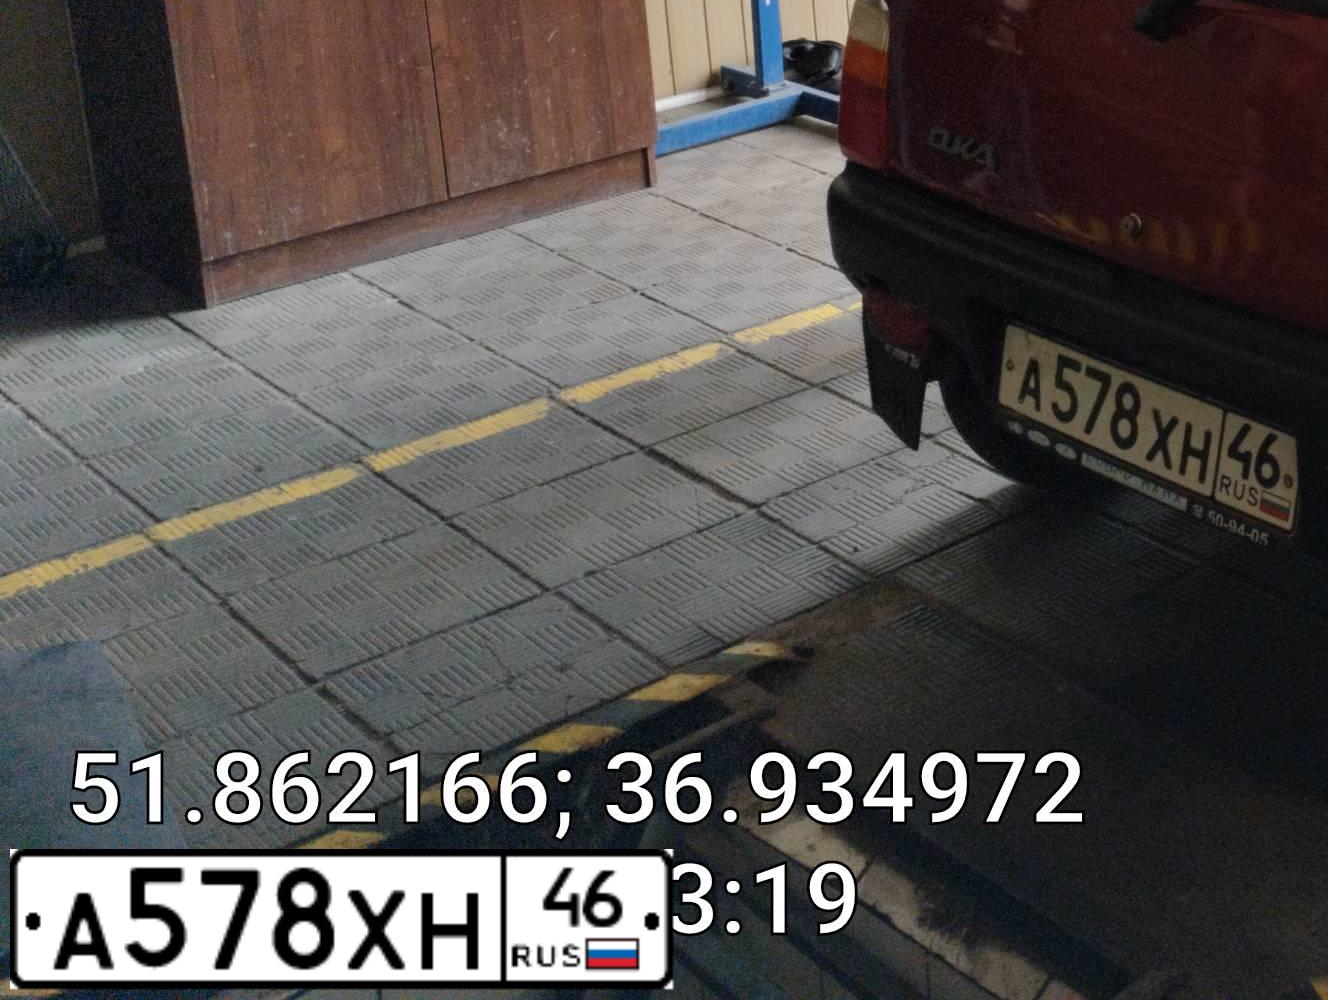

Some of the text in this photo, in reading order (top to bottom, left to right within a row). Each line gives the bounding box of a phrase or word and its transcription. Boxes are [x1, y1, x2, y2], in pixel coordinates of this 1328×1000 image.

[1017, 353, 1213, 485] А578ХН
[1227, 423, 1281, 490] 46
[1219, 474, 1259, 507] RUS
